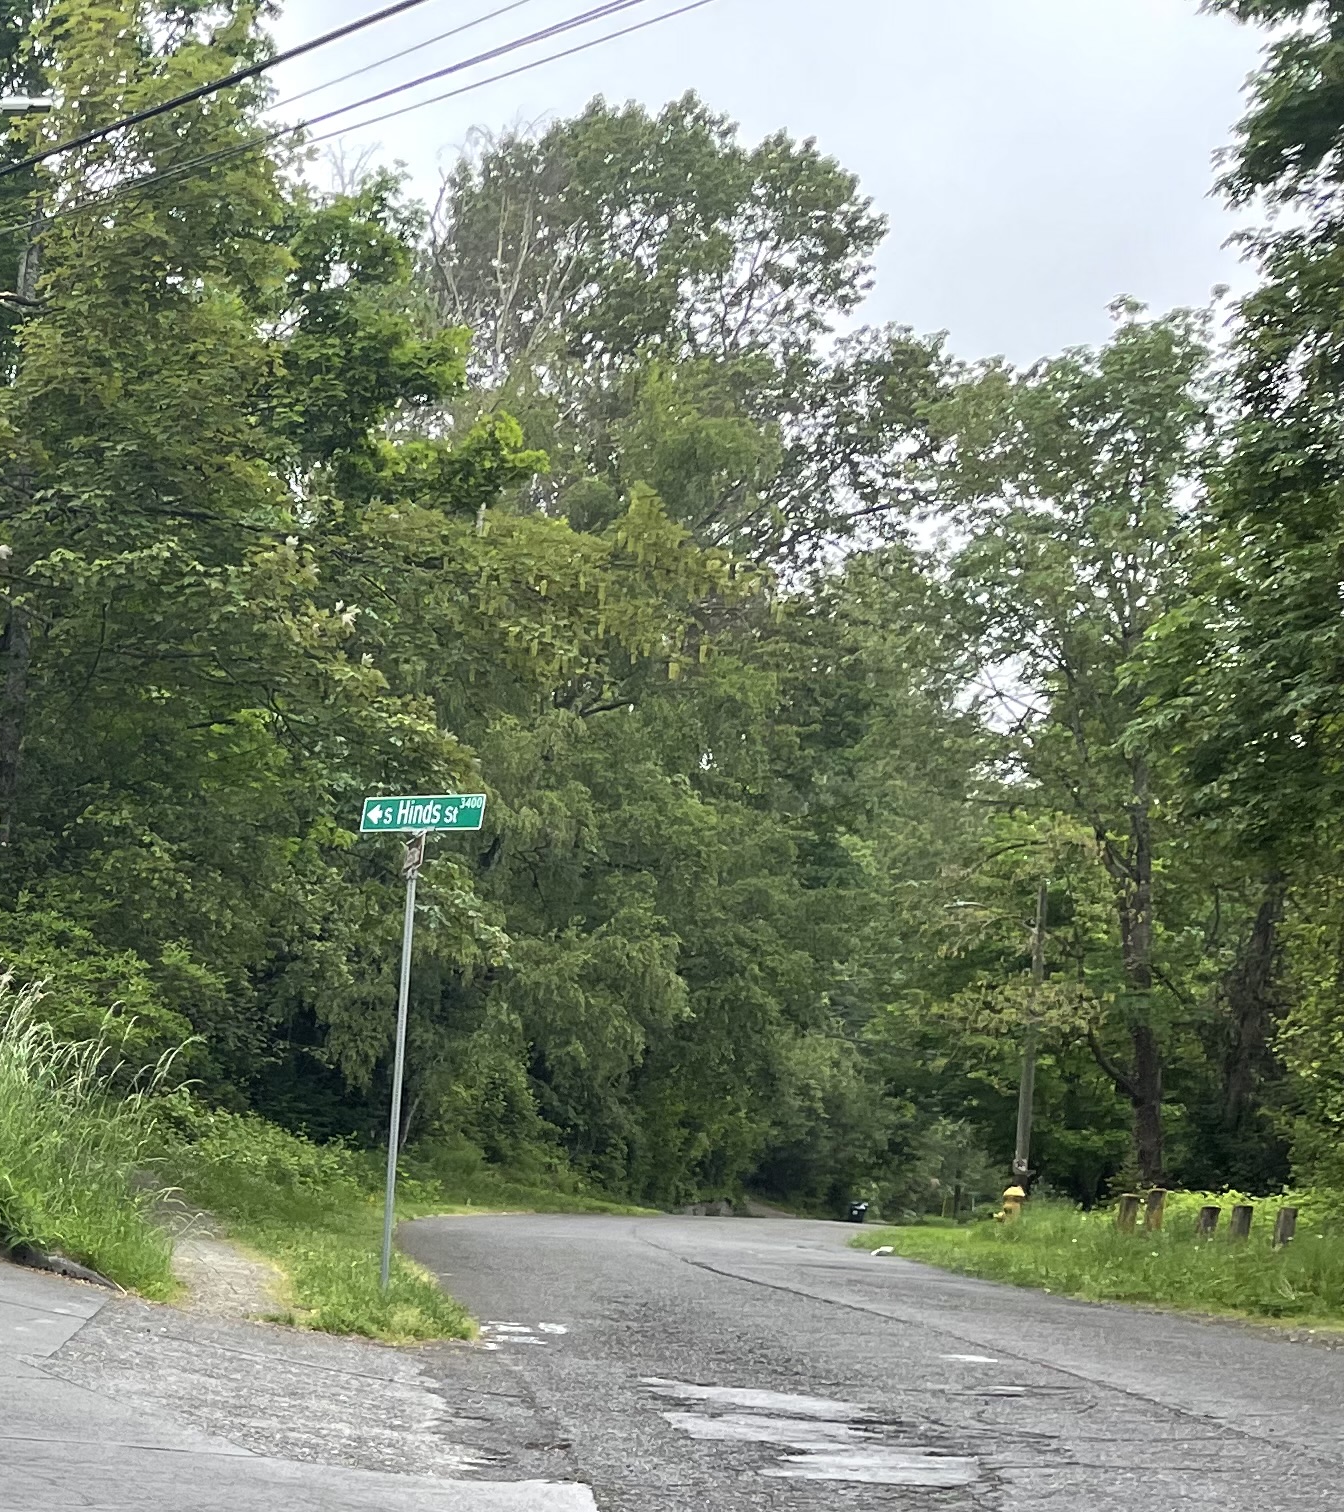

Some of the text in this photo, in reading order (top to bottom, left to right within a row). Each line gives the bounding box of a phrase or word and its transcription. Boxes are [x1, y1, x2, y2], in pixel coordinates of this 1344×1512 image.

[396, 800, 441, 824] Hinds
[444, 806, 459, 824] St
[460, 797, 482, 809] 3400
